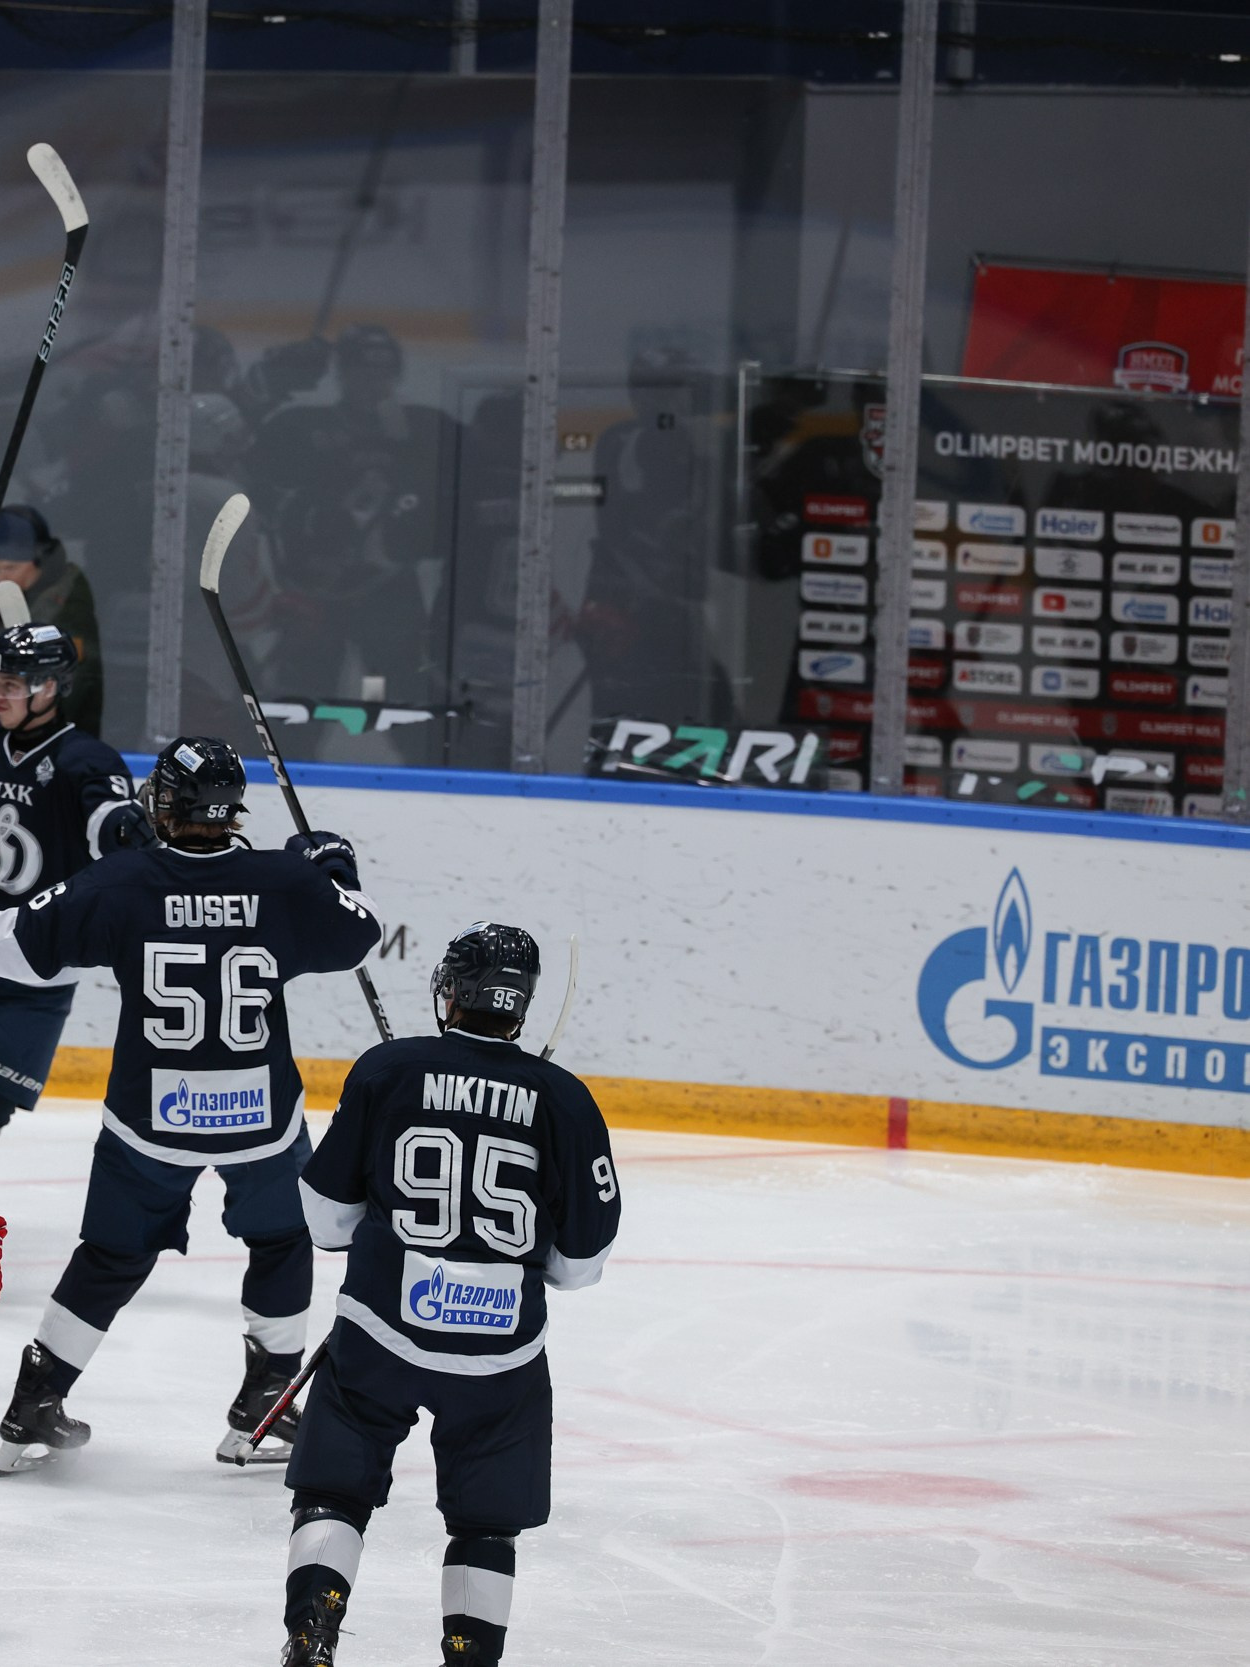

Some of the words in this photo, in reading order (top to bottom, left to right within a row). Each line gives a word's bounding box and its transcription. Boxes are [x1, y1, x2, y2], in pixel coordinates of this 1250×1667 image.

[935, 431, 1069, 462] OLIMPBET
[1073, 441, 1240, 474] МОЛОДЕЖН
[1040, 514, 1098, 535] Haier
[207, 804, 229, 819] 56
[164, 894, 259, 928] GUSEV
[1042, 931, 1250, 1022] ГАЗПРО
[143, 942, 279, 1052] 56
[492, 989, 517, 1011] 95
[191, 1088, 265, 1112] ГАЗПРОМ
[422, 1073, 538, 1128] NIKITIN
[193, 1112, 265, 1127] ЭКСПОРТ
[392, 1126, 540, 1257] 95
[444, 1282, 517, 1310] ГАЗПРОМ
[443, 1311, 514, 1329] ЭКСПОРТ
